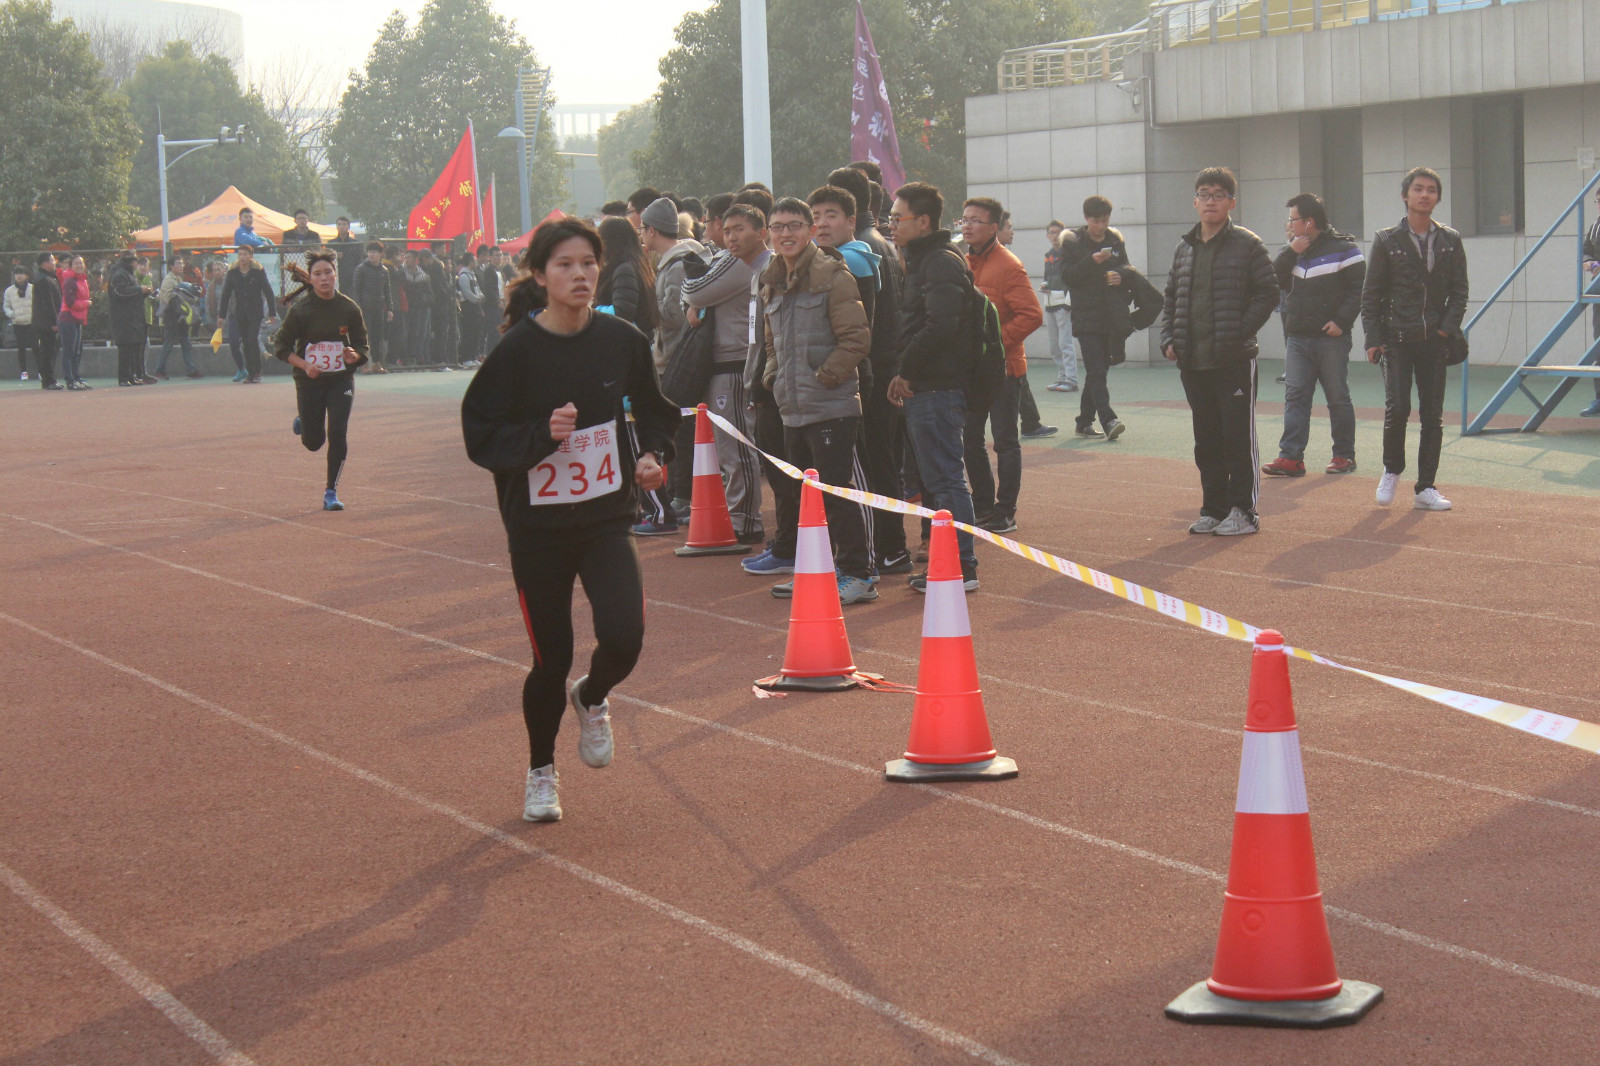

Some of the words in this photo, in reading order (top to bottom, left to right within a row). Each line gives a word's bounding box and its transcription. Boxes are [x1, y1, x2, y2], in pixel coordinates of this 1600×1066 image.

[308, 355, 342, 370] 235
[556, 429, 611, 454] 理学院
[536, 452, 616, 498] 234
